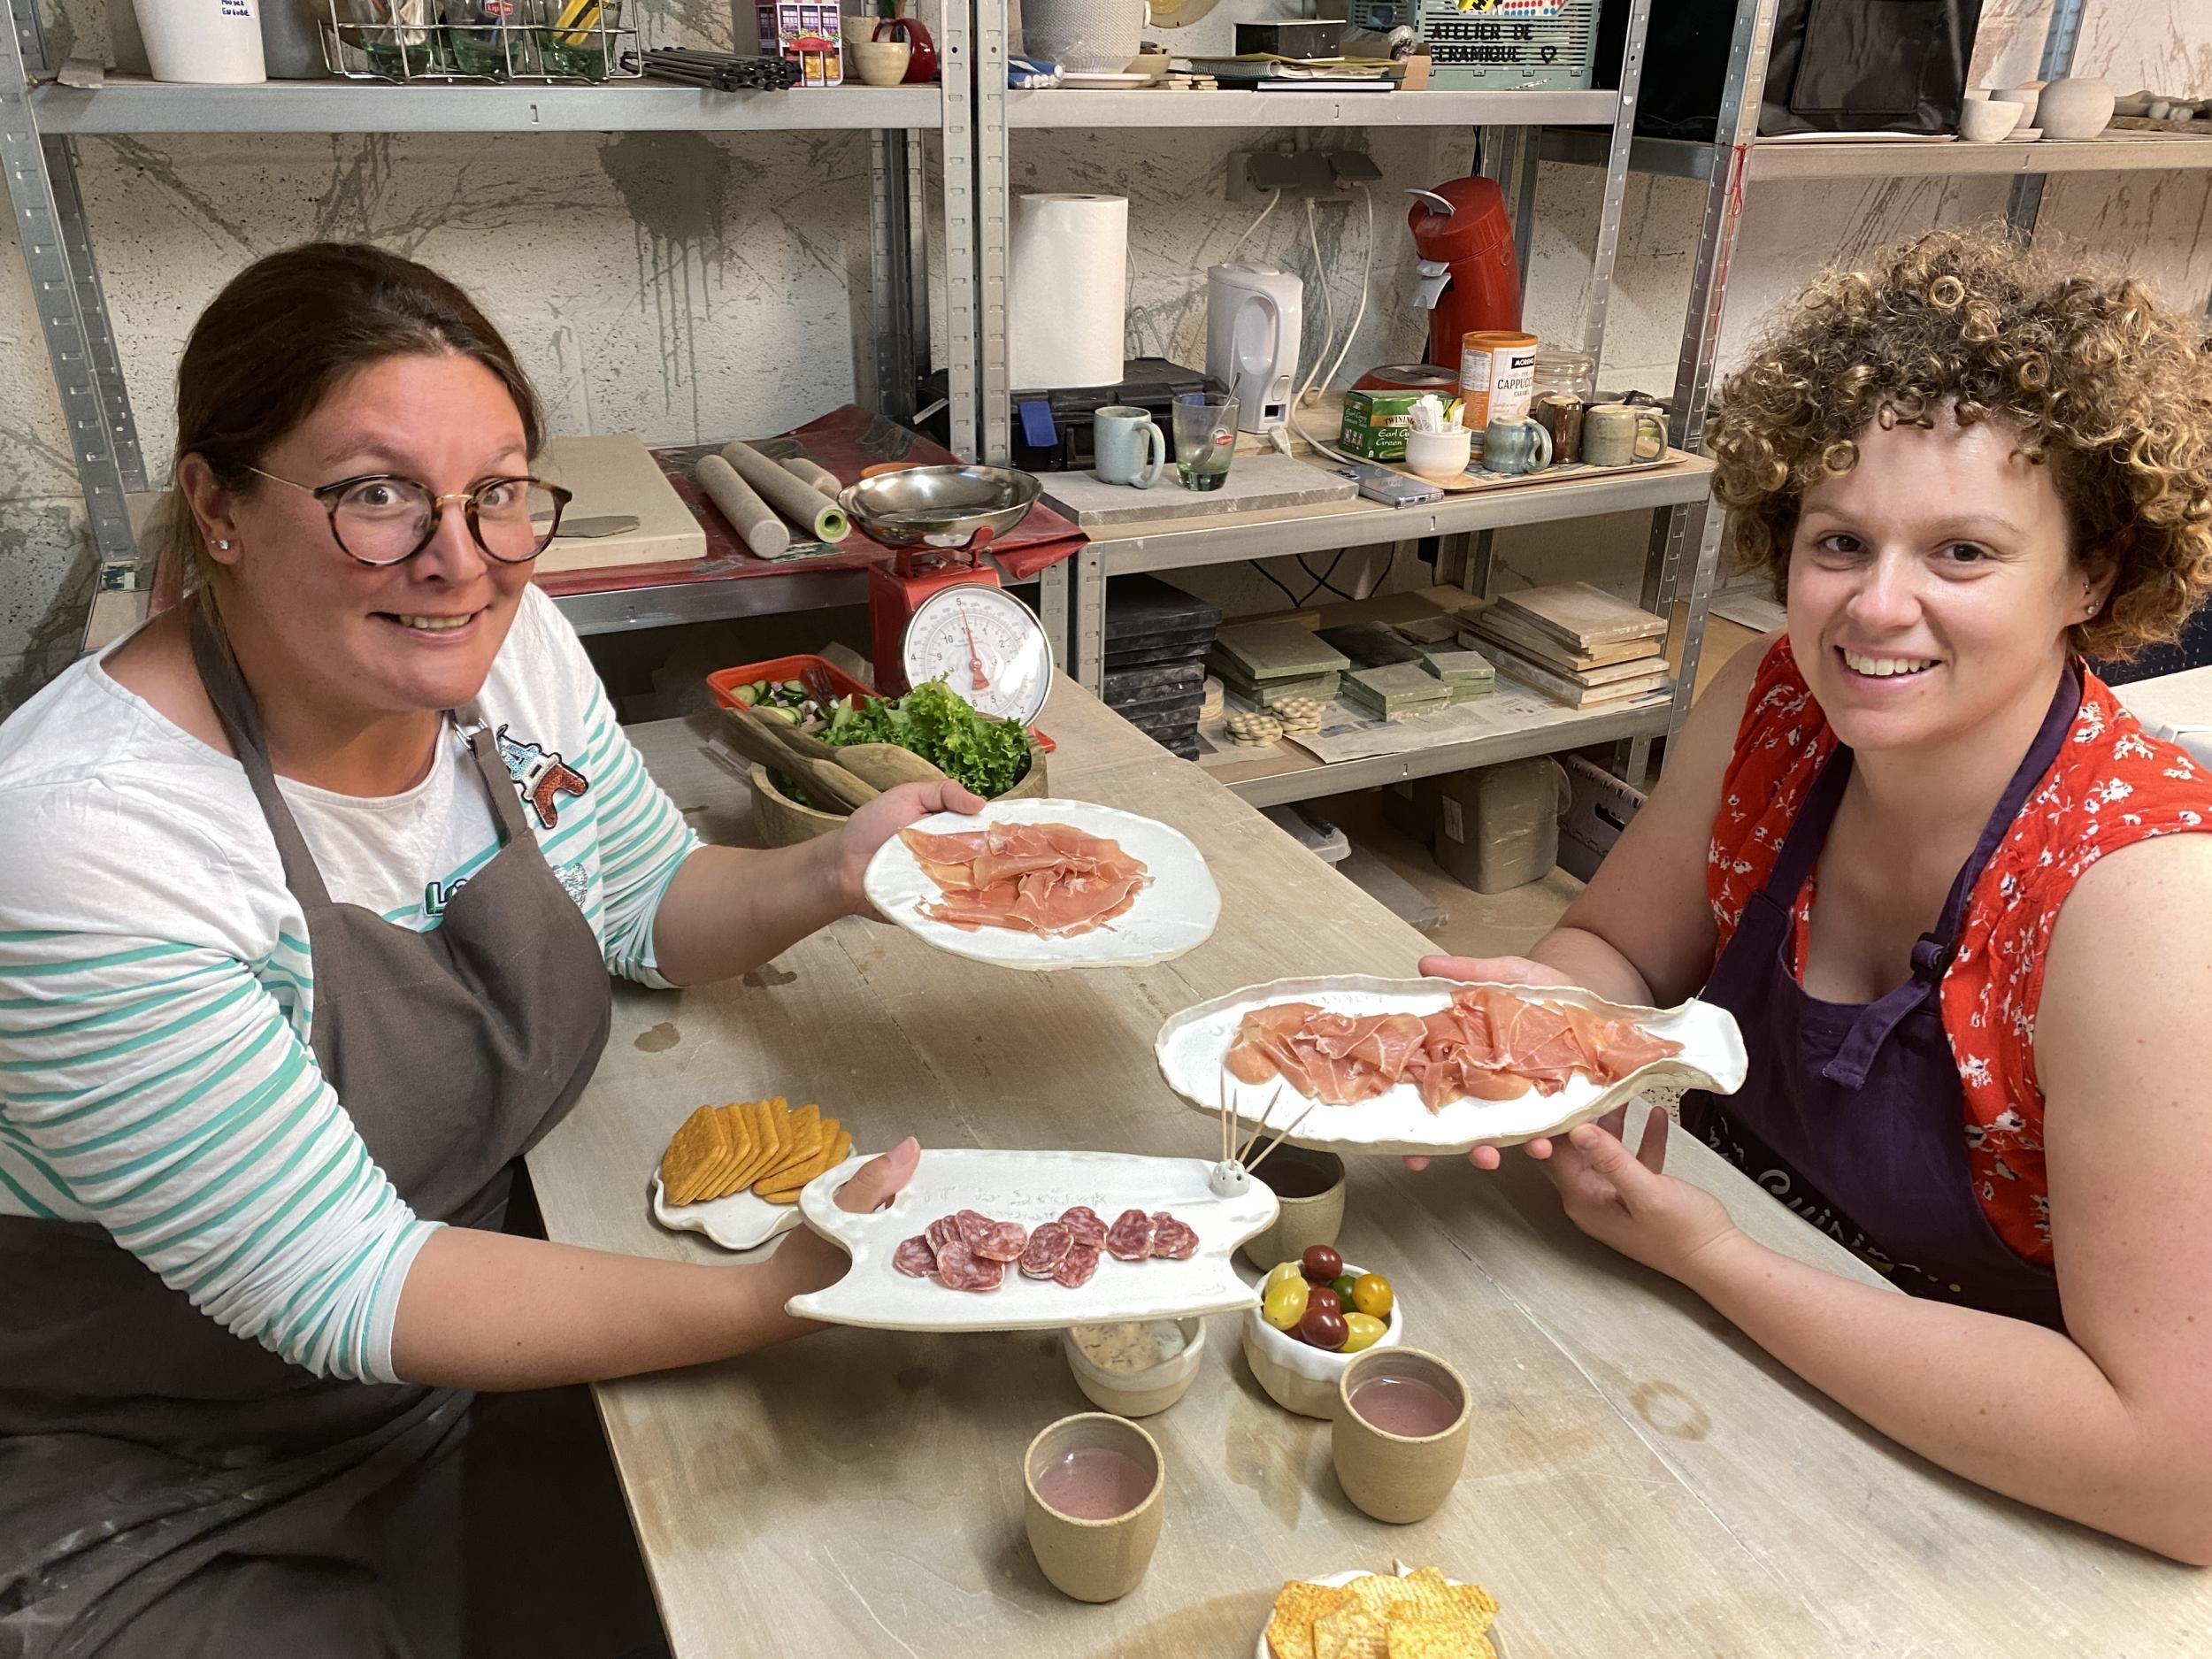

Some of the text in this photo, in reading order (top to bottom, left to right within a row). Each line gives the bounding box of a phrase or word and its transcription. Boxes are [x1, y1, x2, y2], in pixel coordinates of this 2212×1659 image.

[487, 4, 511, 14] Lipn
[1431, 23, 1501, 40] ATELIER
[1384, 416, 1416, 426] TWINING
[1378, 428, 1398, 438] Earl
[1375, 438, 1402, 447] Green
[956, 597, 962, 606] 5
[944, 634, 954, 644] 10
[998, 640, 1005, 649] 2
[936, 652, 942, 661] 9
[972, 698, 978, 708] 6
[990, 695, 997, 703] 5
[1018, 705, 1026, 714] 2
